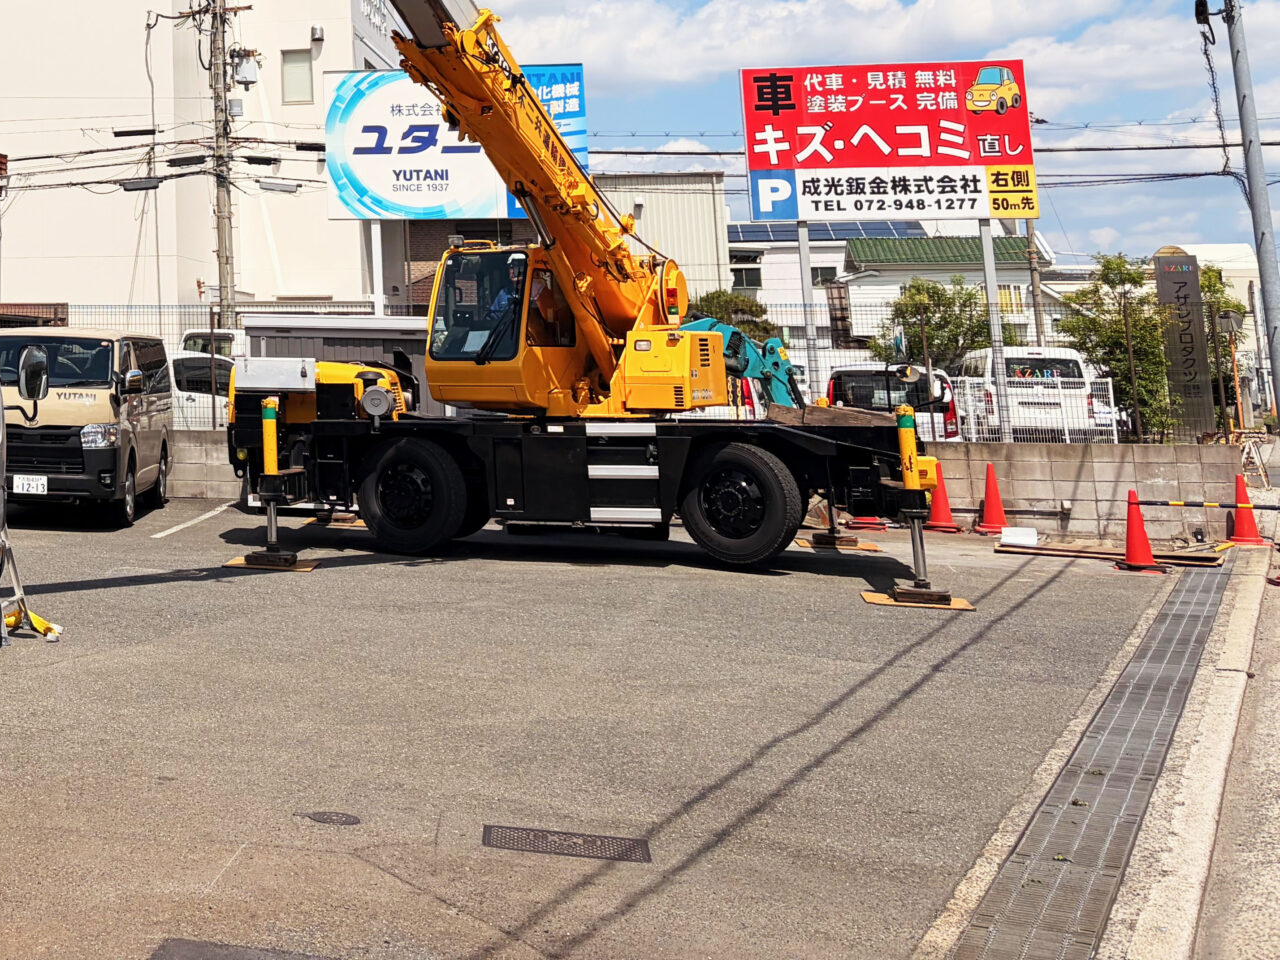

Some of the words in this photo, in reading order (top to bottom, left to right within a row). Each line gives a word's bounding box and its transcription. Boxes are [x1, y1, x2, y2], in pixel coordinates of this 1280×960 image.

[804, 71, 907, 91] 代車・見積
[915, 69, 957, 88] 無料
[753, 72, 796, 116] 車
[806, 93, 908, 114] 塗装ブース
[916, 91, 958, 110] 完備
[976, 134, 1024, 158] 直し
[392, 169, 449, 181] YUTANI
[990, 170, 1029, 187] 右側
[392, 183, 423, 192] SINCE
[426, 183, 449, 192] 1937
[801, 174, 982, 196] 成光鈑金株式会社
[757, 178, 793, 212] P
[992, 195, 1035, 212] 50m先
[811, 199, 847, 212] TEL
[854, 197, 978, 212] 072-948-1277
[56, 392, 96, 400] YUTANI
[21, 482, 46, 493] 12-13
